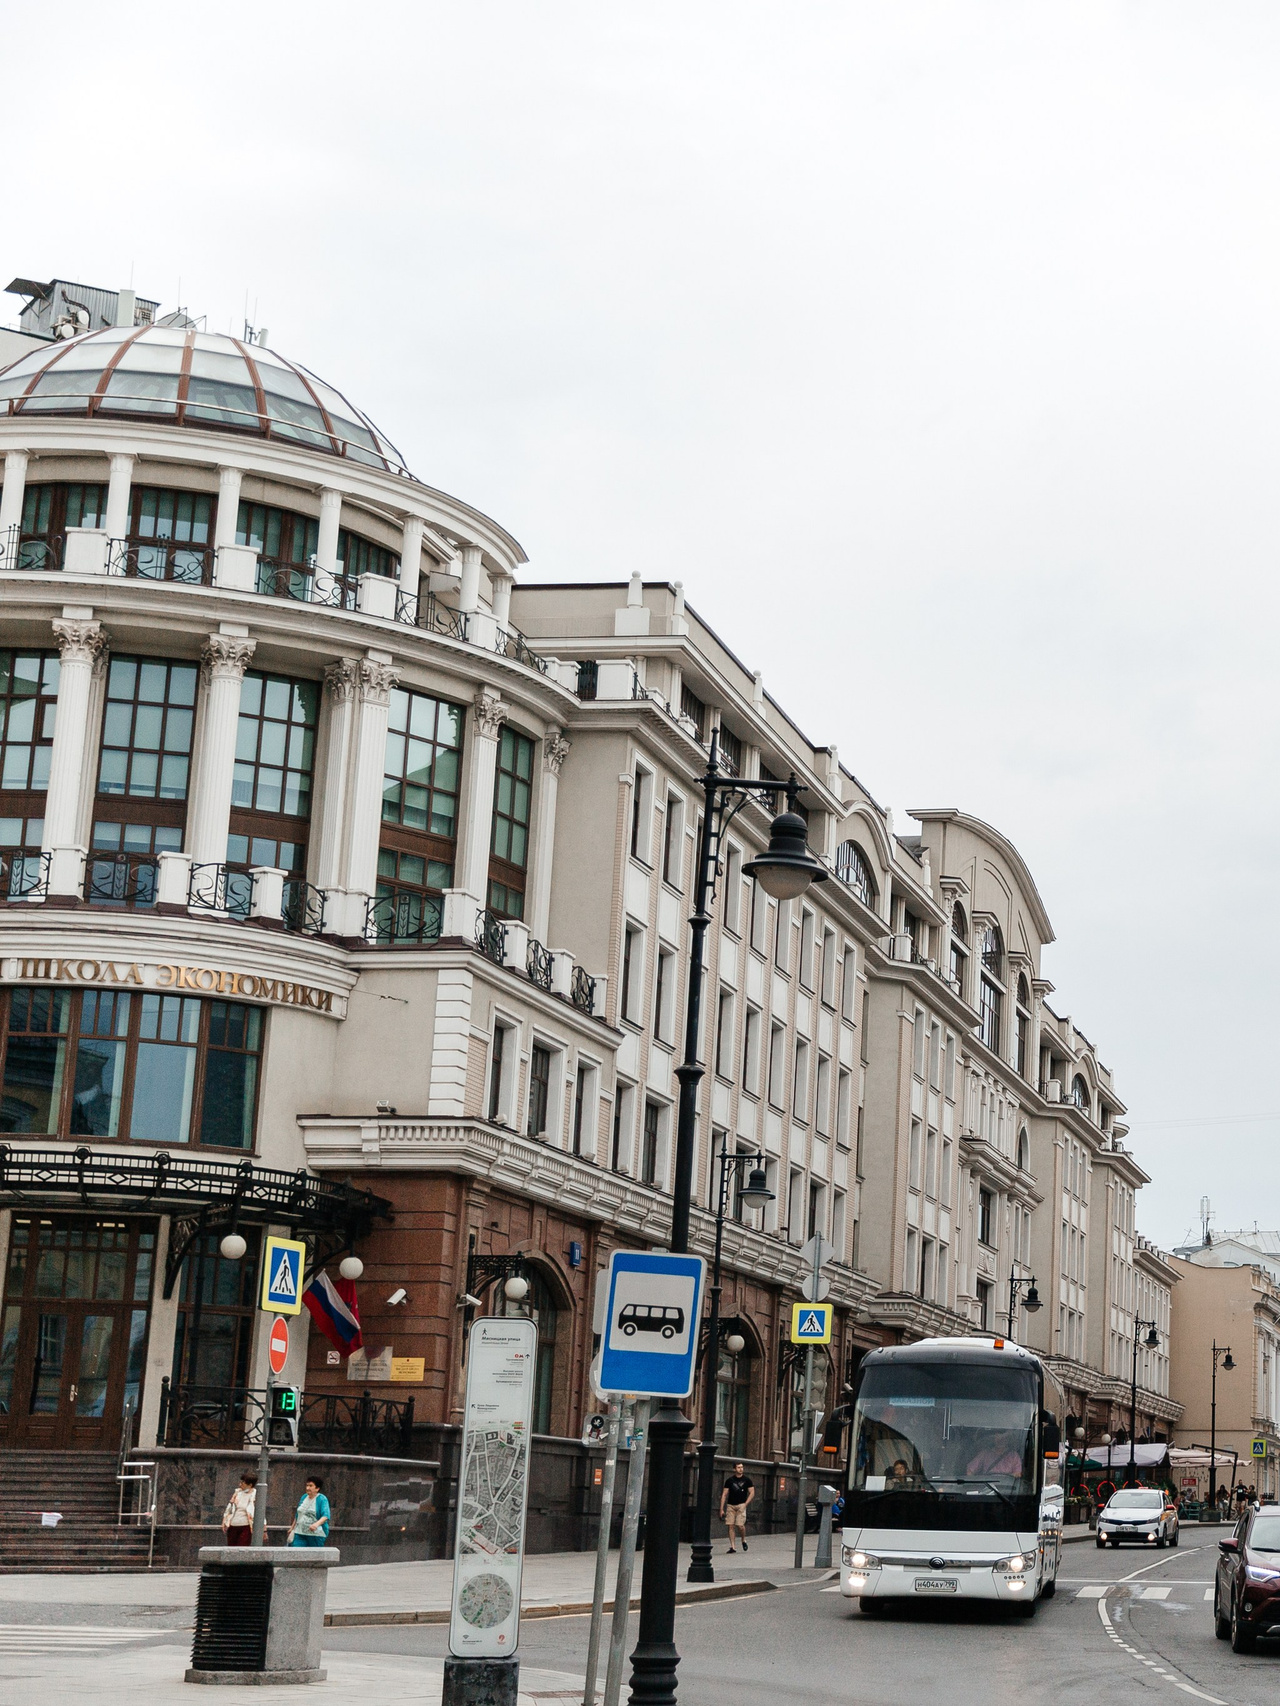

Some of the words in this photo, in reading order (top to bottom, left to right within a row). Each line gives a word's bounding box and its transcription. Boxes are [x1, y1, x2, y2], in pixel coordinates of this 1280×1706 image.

[18, 957, 144, 985] ШКОЛА
[156, 963, 335, 1013] ЭКОНОМИКИ
[281, 1392, 295, 1411] 13
